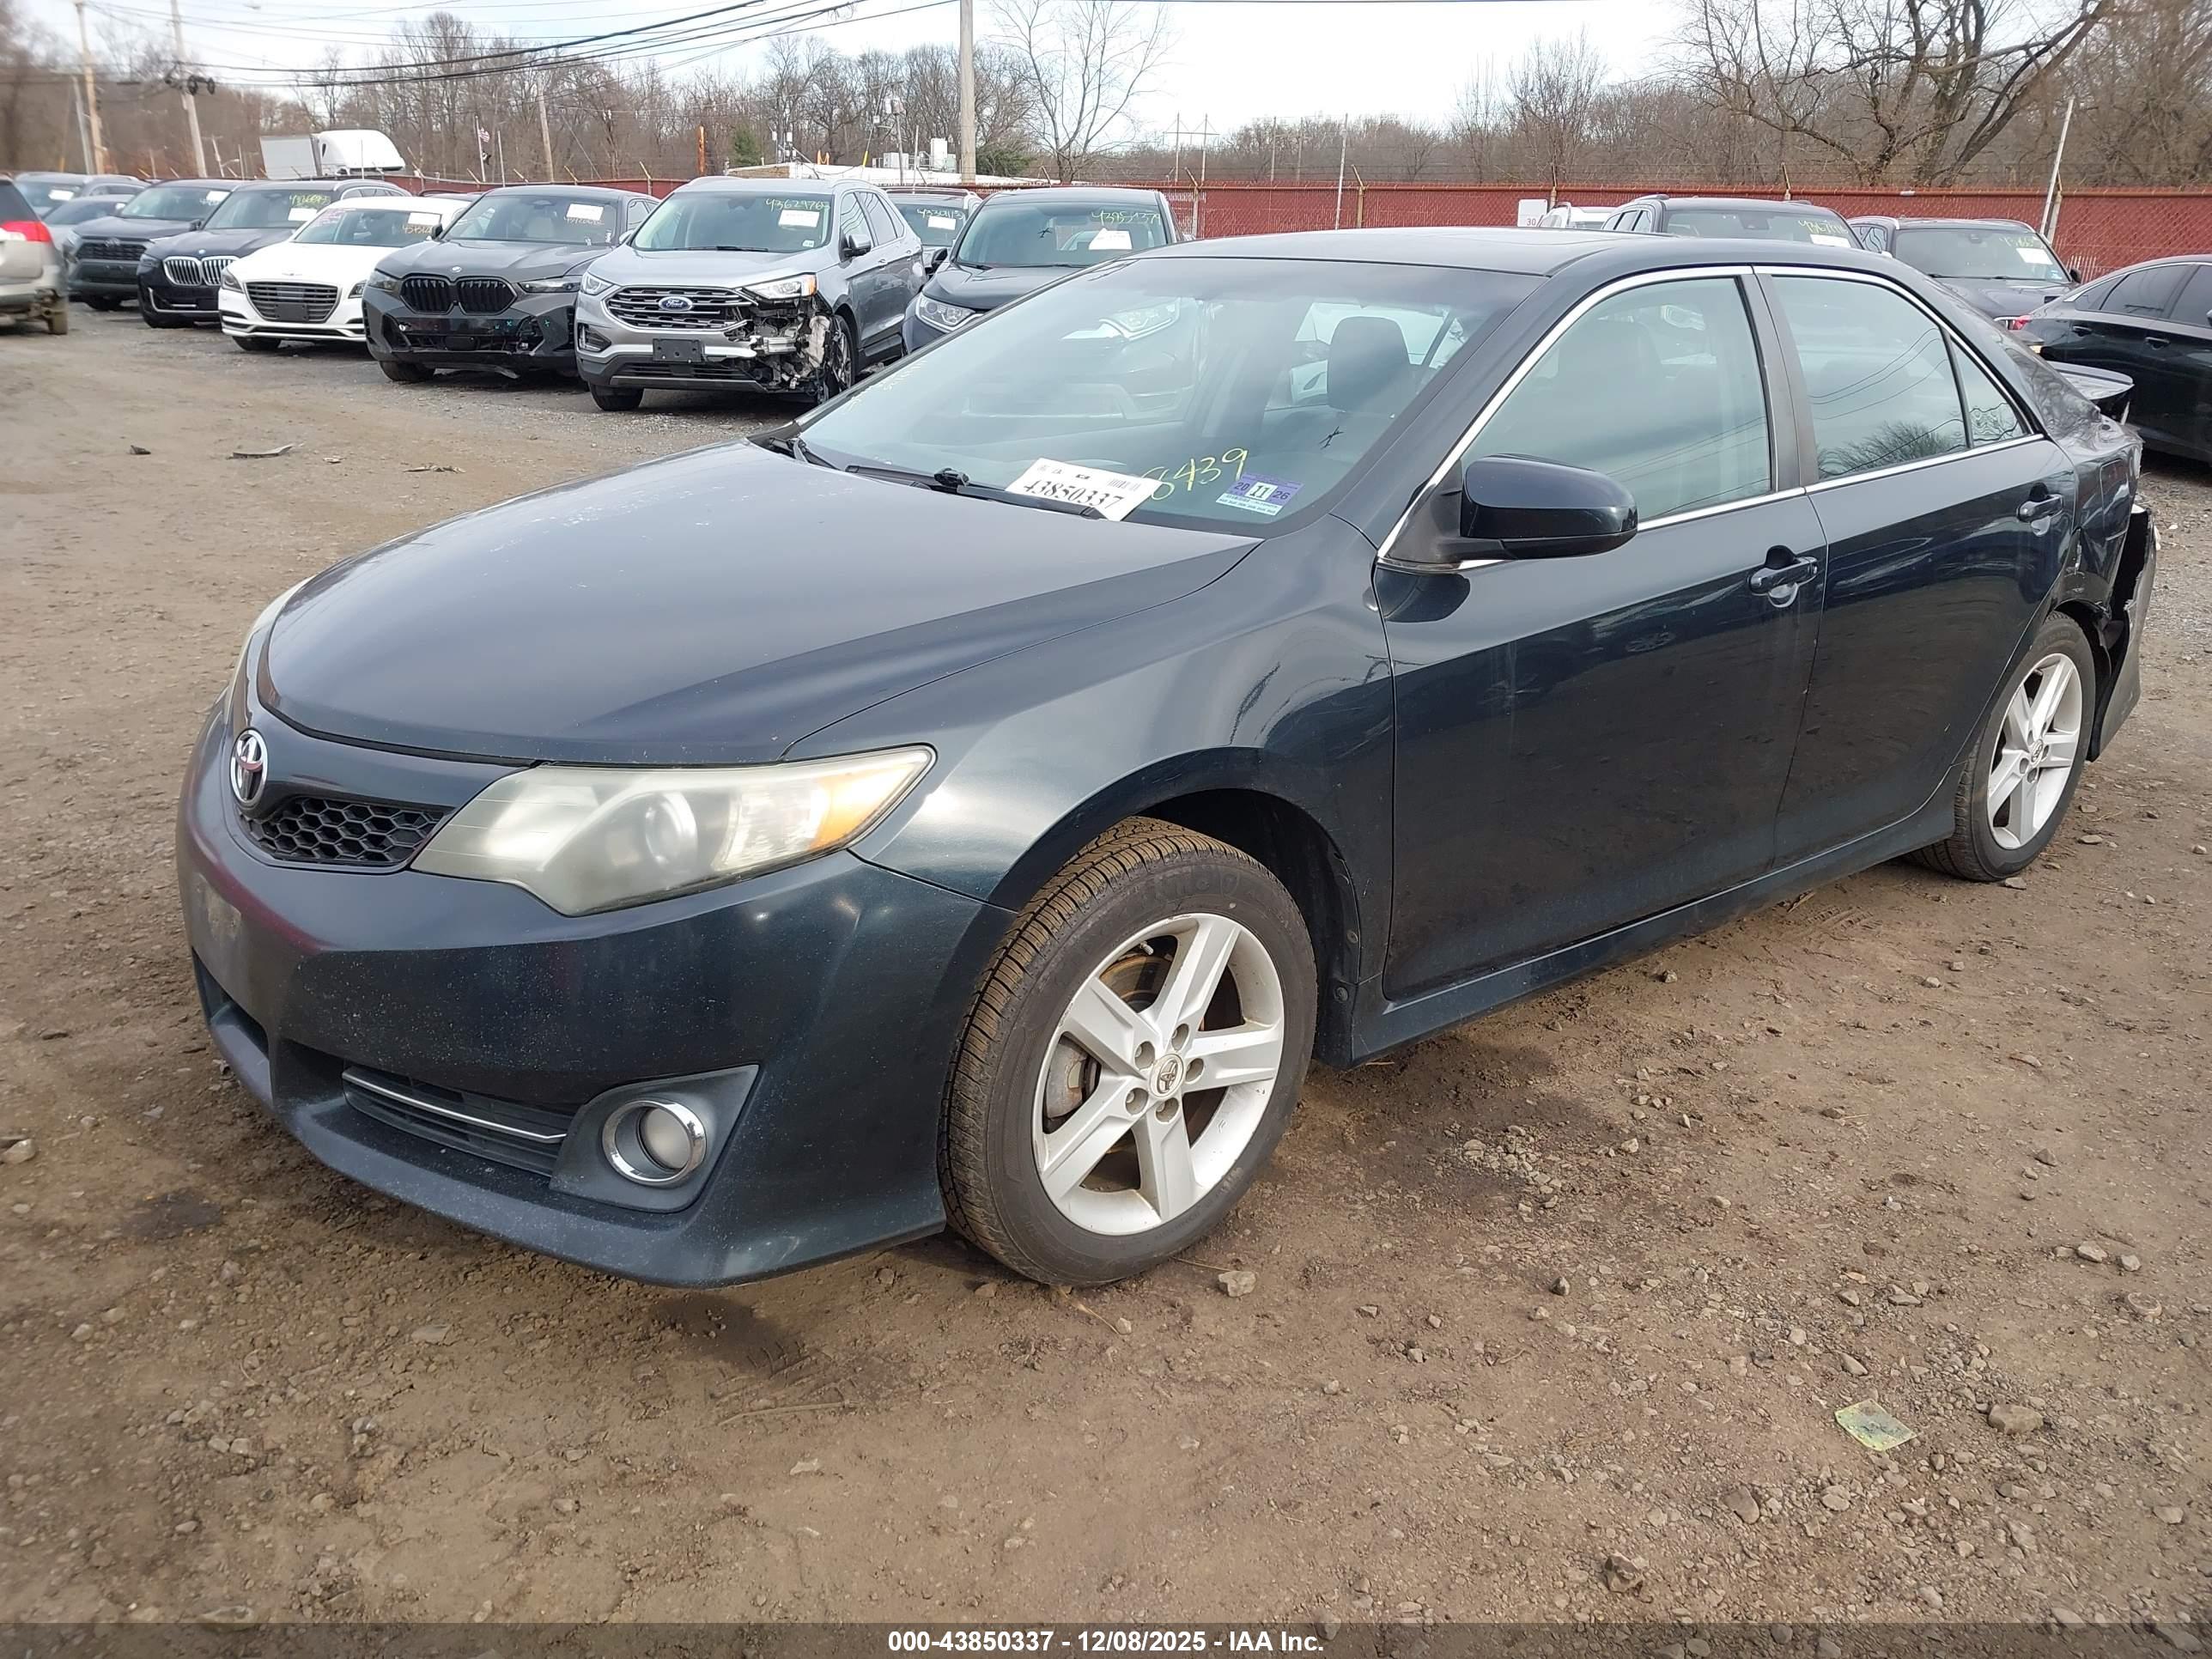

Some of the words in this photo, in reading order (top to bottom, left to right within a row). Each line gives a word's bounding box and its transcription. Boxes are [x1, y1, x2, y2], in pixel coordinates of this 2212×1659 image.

[1526, 217, 1537, 227] 30
[1024, 479, 1125, 509] 43850337
[1234, 482, 1250, 491] 20
[1249, 485, 1271, 498] 11
[1272, 490, 1291, 500] 26
